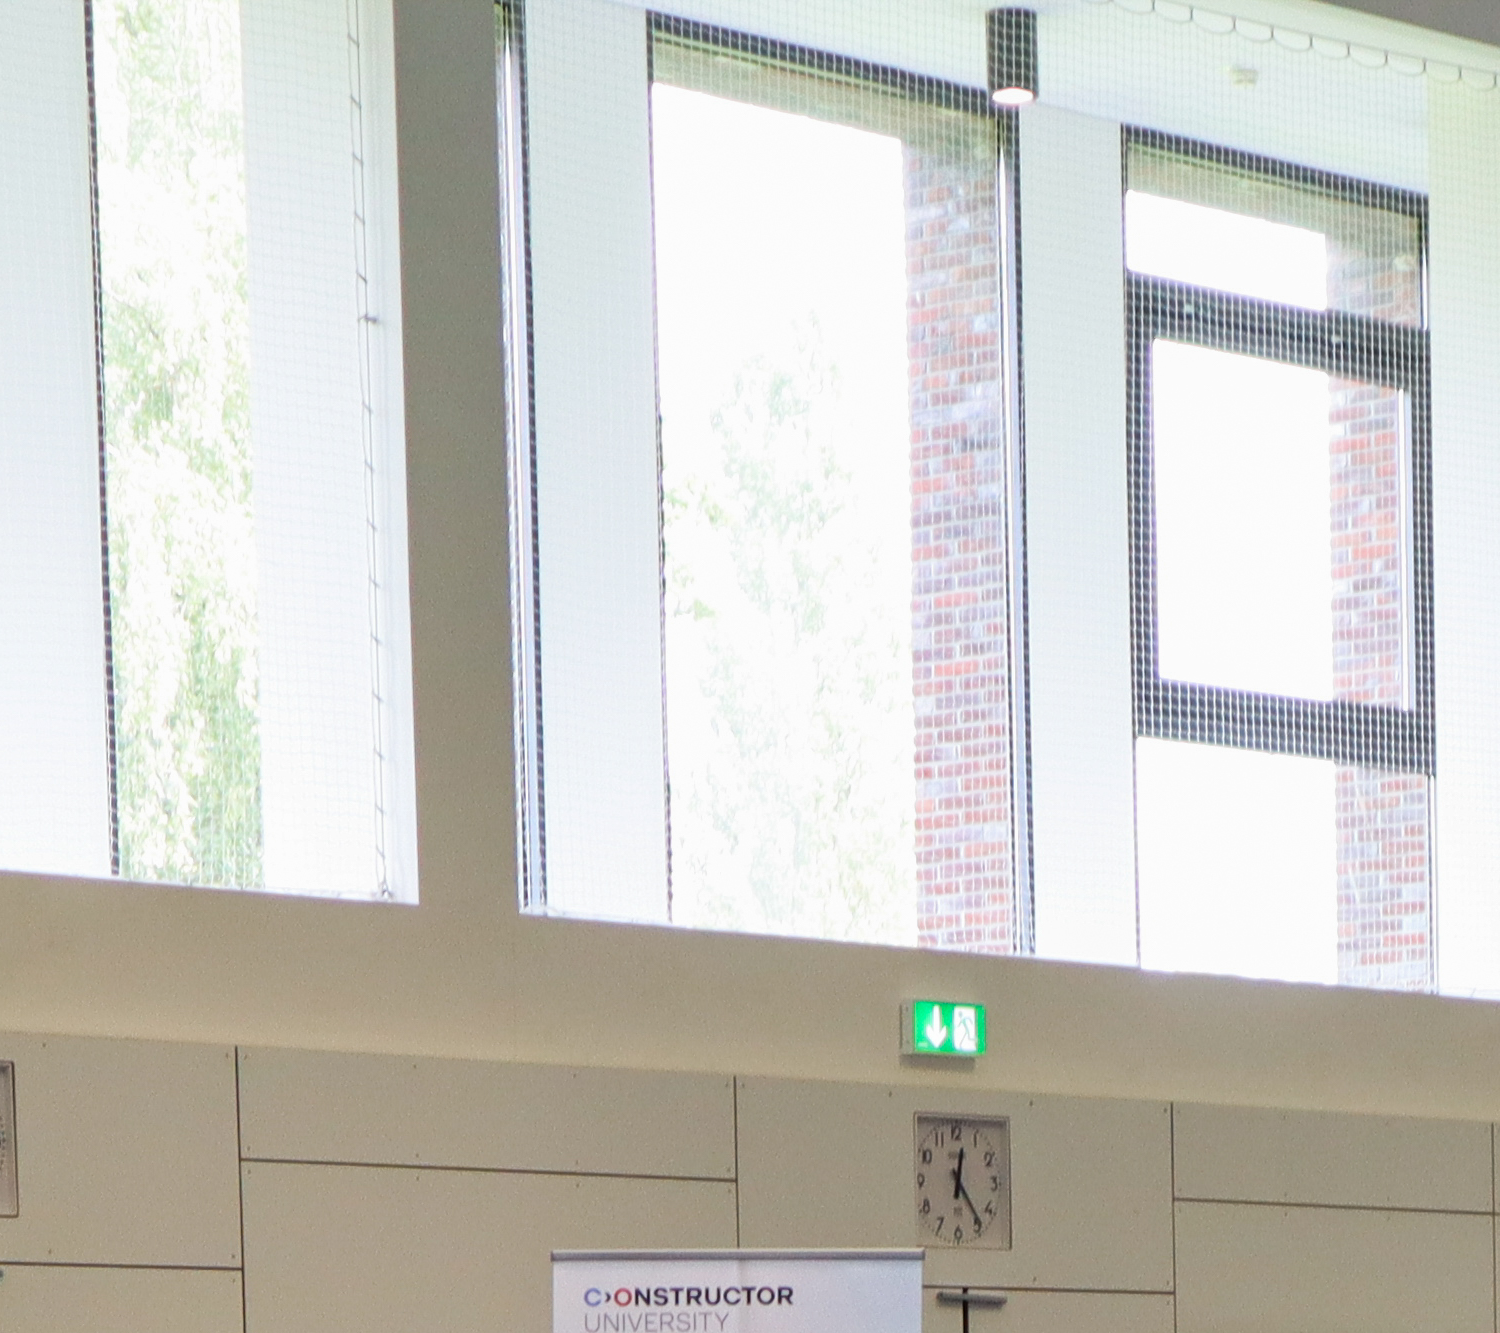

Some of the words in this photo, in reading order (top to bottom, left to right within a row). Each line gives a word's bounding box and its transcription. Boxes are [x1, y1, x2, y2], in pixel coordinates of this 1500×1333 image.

[935, 1131, 944, 1148] 11
[950, 1125, 962, 1141] 12
[922, 1149, 933, 1164] 10
[984, 1152, 994, 1167] 2
[916, 1173, 925, 1189] 9
[990, 1176, 998, 1191] 3
[922, 1198, 930, 1214] 8
[984, 1201, 993, 1215] 4
[936, 1217, 944, 1236] 7
[954, 1224, 963, 1240] 6
[584, 1312, 730, 1333] UNIVERSITY
